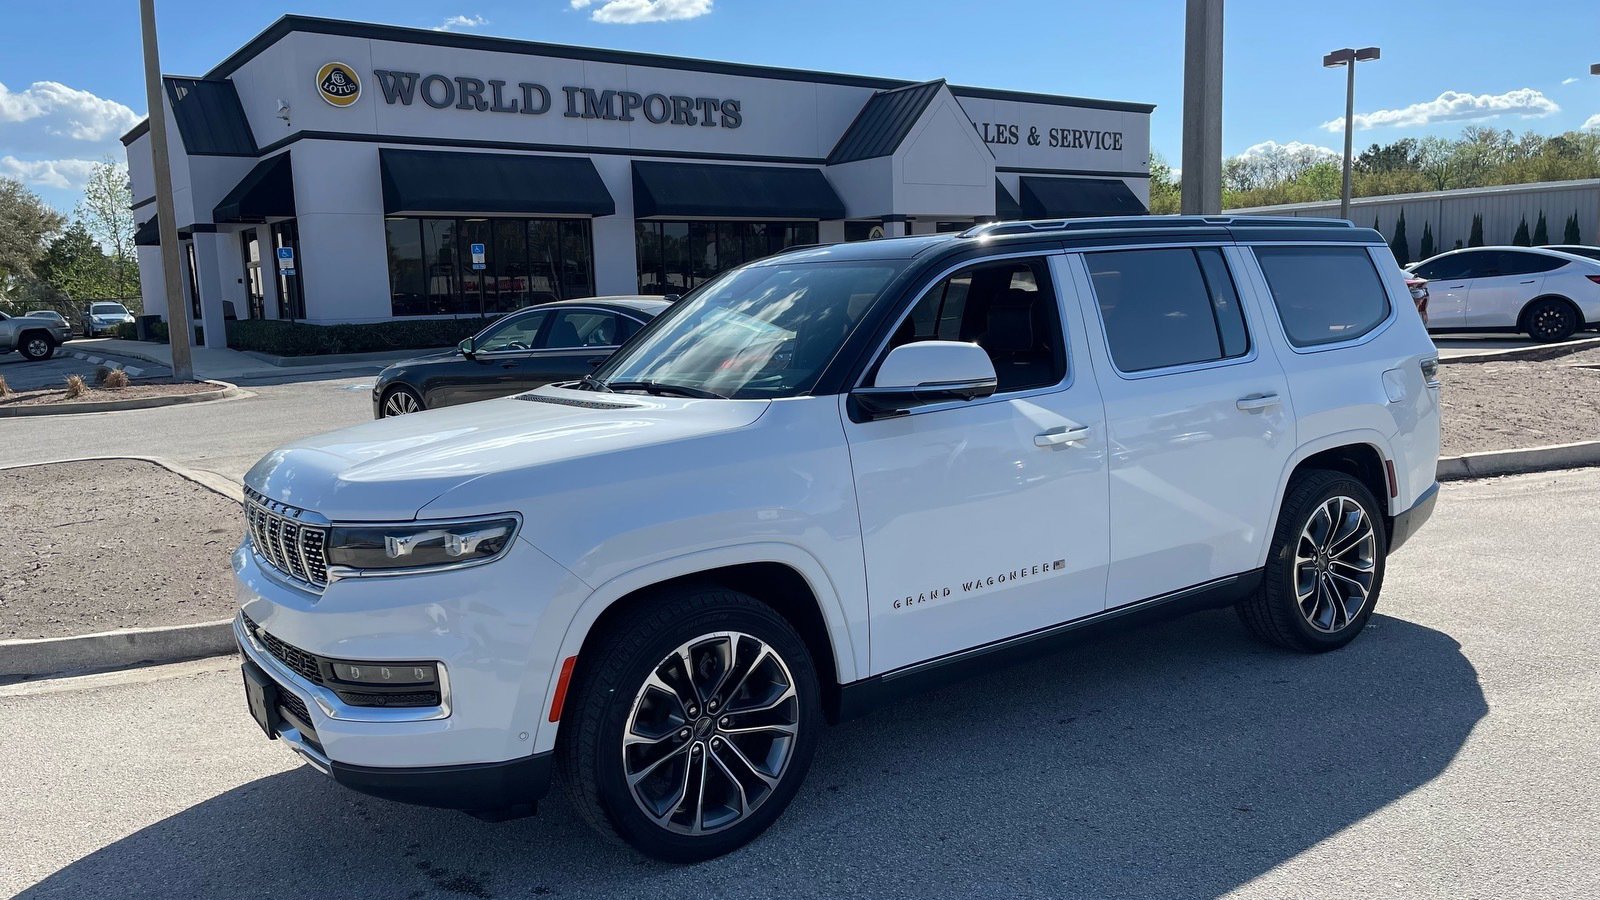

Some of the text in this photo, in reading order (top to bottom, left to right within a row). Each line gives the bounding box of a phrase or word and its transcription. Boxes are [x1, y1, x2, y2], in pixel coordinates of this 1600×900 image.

[323, 82, 356, 94] LOTUS
[373, 69, 742, 129] WORLD IMPORTS
[973, 122, 1123, 151] LES & SERVICE
[893, 562, 1050, 609] GRAND WAGONEER
